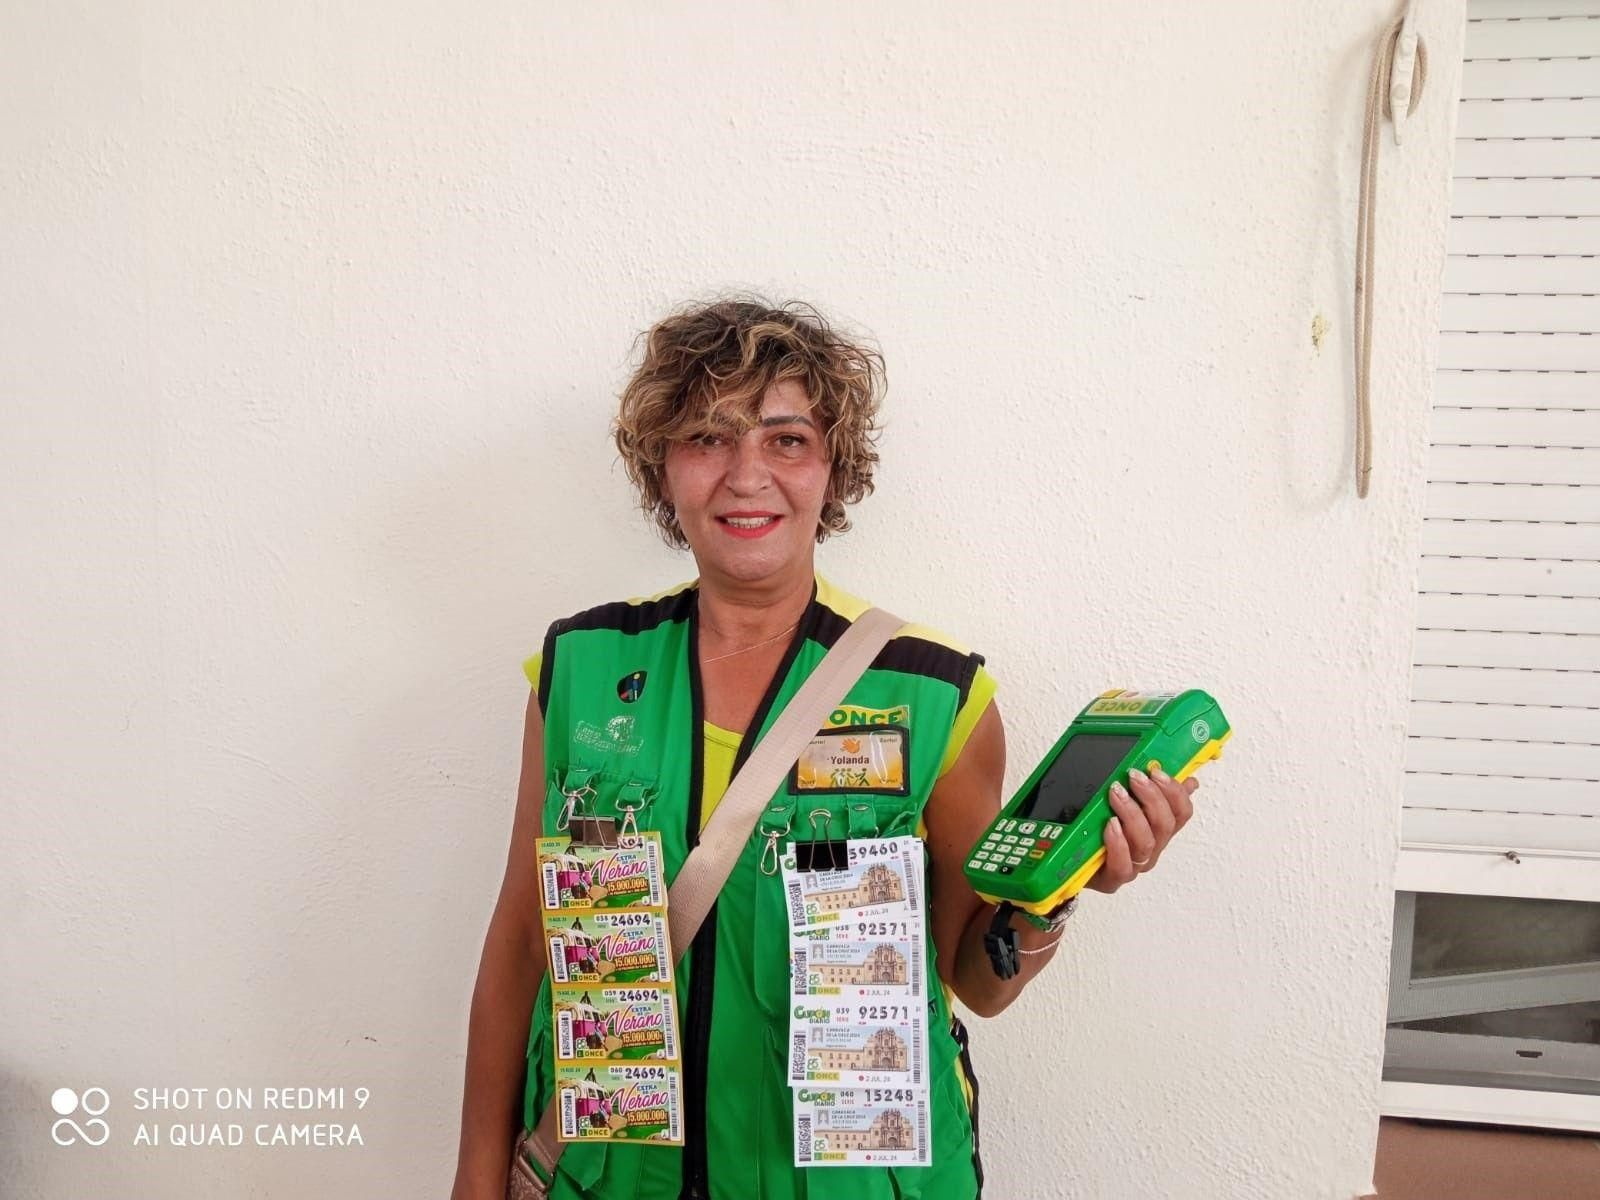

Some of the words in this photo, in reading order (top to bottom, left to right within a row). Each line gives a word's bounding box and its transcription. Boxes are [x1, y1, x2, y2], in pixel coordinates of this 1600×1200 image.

[1095, 702, 1140, 712] ONCE
[830, 710, 902, 725] ONCE
[831, 756, 870, 764] Yolanda
[848, 842, 898, 860] 59460
[590, 853, 648, 886] Verano
[610, 914, 650, 926] 24694
[816, 914, 839, 922] ONCE
[858, 922, 907, 936] 92571
[598, 929, 654, 960] Verano
[620, 990, 658, 1002] 24694
[606, 1004, 662, 1036] Verano
[859, 1006, 908, 1020] 92571
[625, 1068, 664, 1079] 24694
[611, 1082, 668, 1116] Verano
[865, 1089, 913, 1102] 15248
